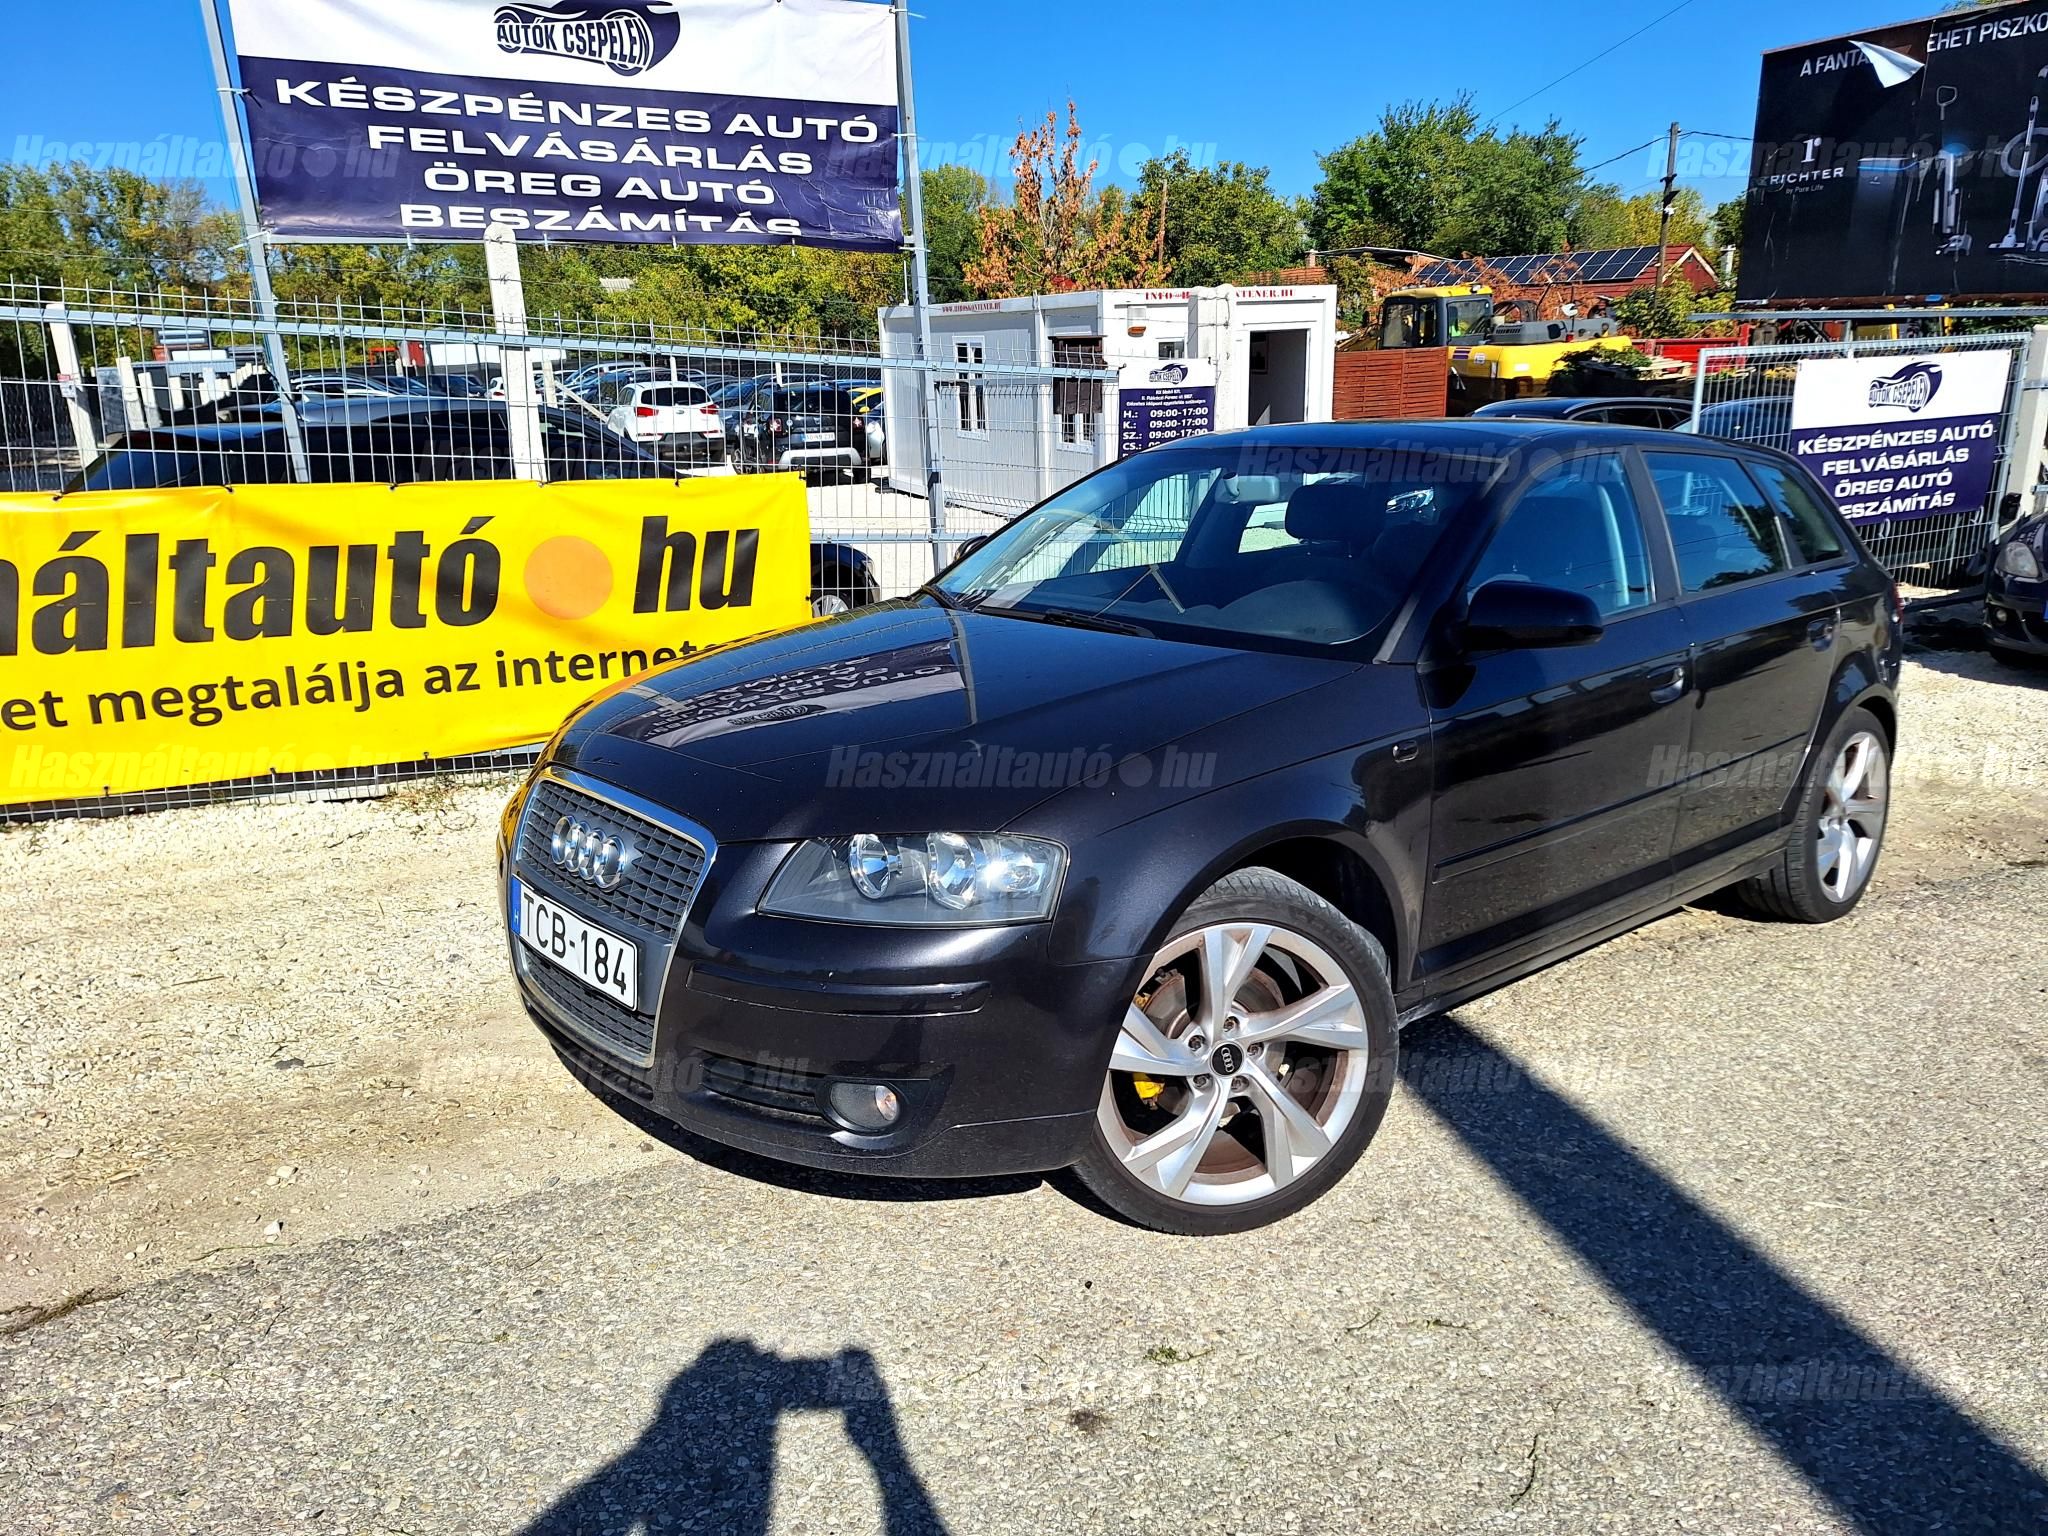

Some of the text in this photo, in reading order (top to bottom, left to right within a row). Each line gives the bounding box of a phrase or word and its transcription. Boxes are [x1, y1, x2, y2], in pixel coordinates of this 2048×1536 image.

[497, 17, 650, 67] AUTÓK CSEPELEN
[1800, 59, 1812, 78] A
[275, 78, 880, 145] KÉSZPÉNZES AUTÓ
[366, 126, 813, 177] FELVÁSÁRLÁS
[424, 160, 775, 206] ÖREG AUTÓ
[1769, 166, 1845, 186] RICHTER
[400, 203, 801, 236] BESZÁMÍTÁS
[1122, 418, 1208, 429] K.: 09:00-17:00
[1123, 407, 1208, 418] H.: 09:00-17:00
[1122, 429, 1208, 440] SZ.: 09:00-17:00
[1122, 442, 1142, 450] CS.:
[1797, 420, 1995, 456] KÉSZPÉNZES AUTÓ
[1821, 445, 1970, 477] FELVÁSÁRLÁS
[1834, 469, 1953, 498] ÖREG AUTÓ
[1839, 492, 1957, 519] ESZÁMÍTÁS
[634, 515, 760, 614] hu
[88, 659, 405, 727] megtalálja
[424, 664, 480, 693] az
[497, 640, 722, 688] internet
[523, 892, 627, 996] TCB-184
